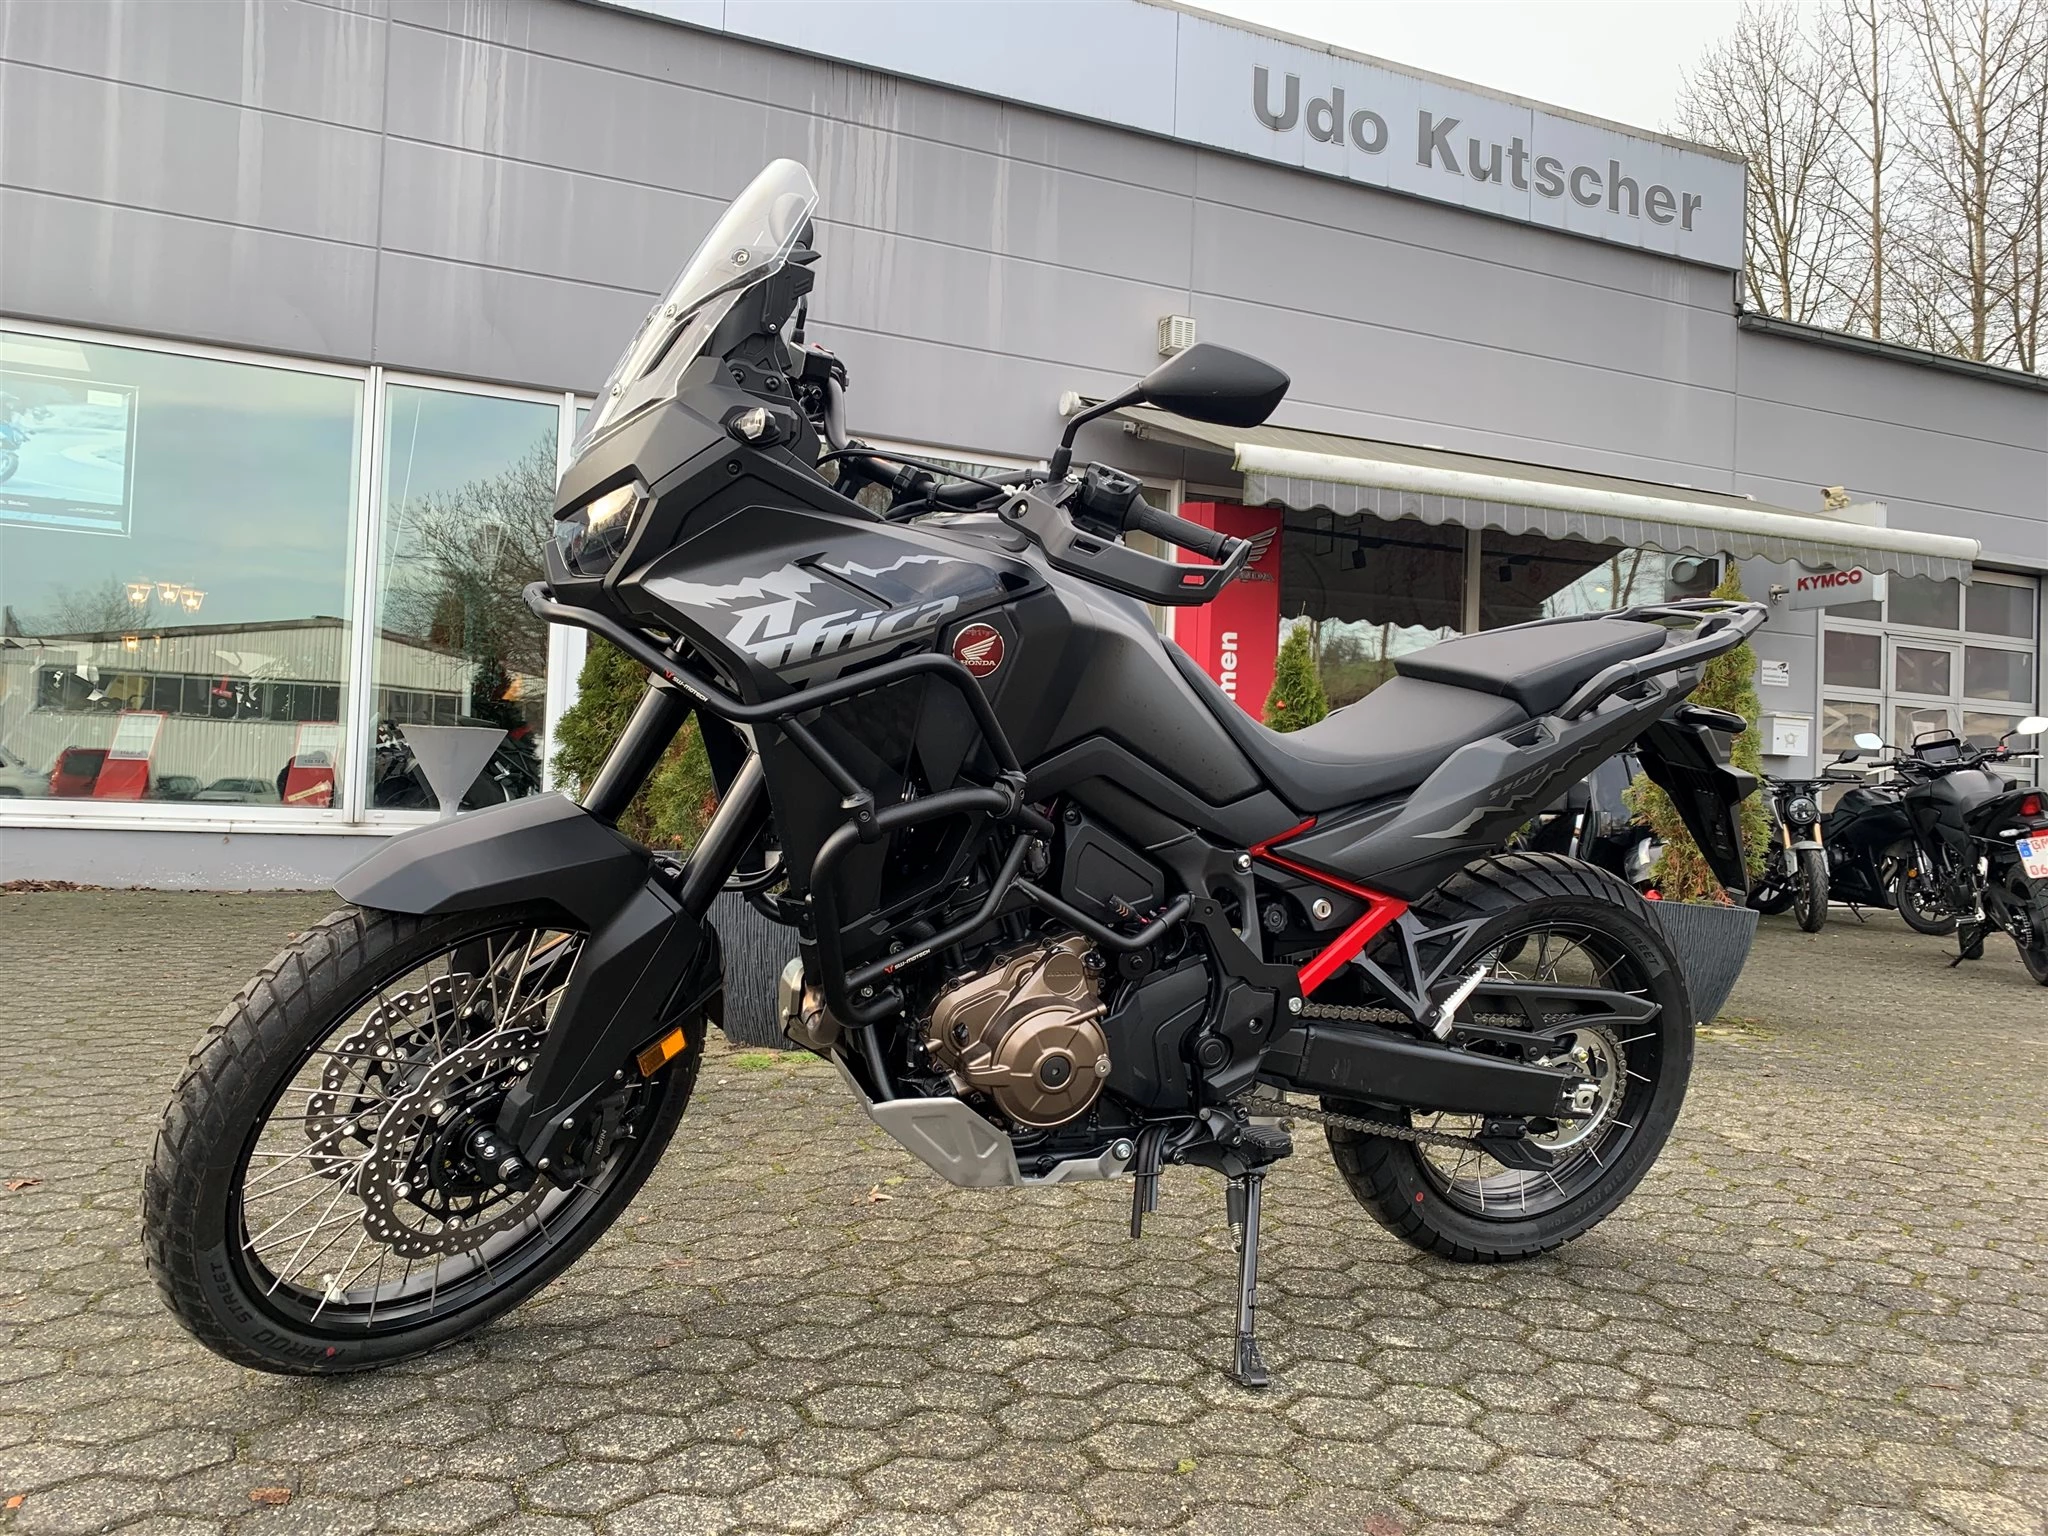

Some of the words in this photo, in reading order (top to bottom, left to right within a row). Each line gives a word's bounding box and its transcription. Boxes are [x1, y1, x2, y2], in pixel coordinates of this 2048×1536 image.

[1252, 64, 1389, 154] Udo
[1416, 109, 1702, 232] Kutscher
[1797, 569, 1863, 592] KYMCO
[1488, 763, 1550, 801] 1100
[210, 1262, 254, 1325] STREET
